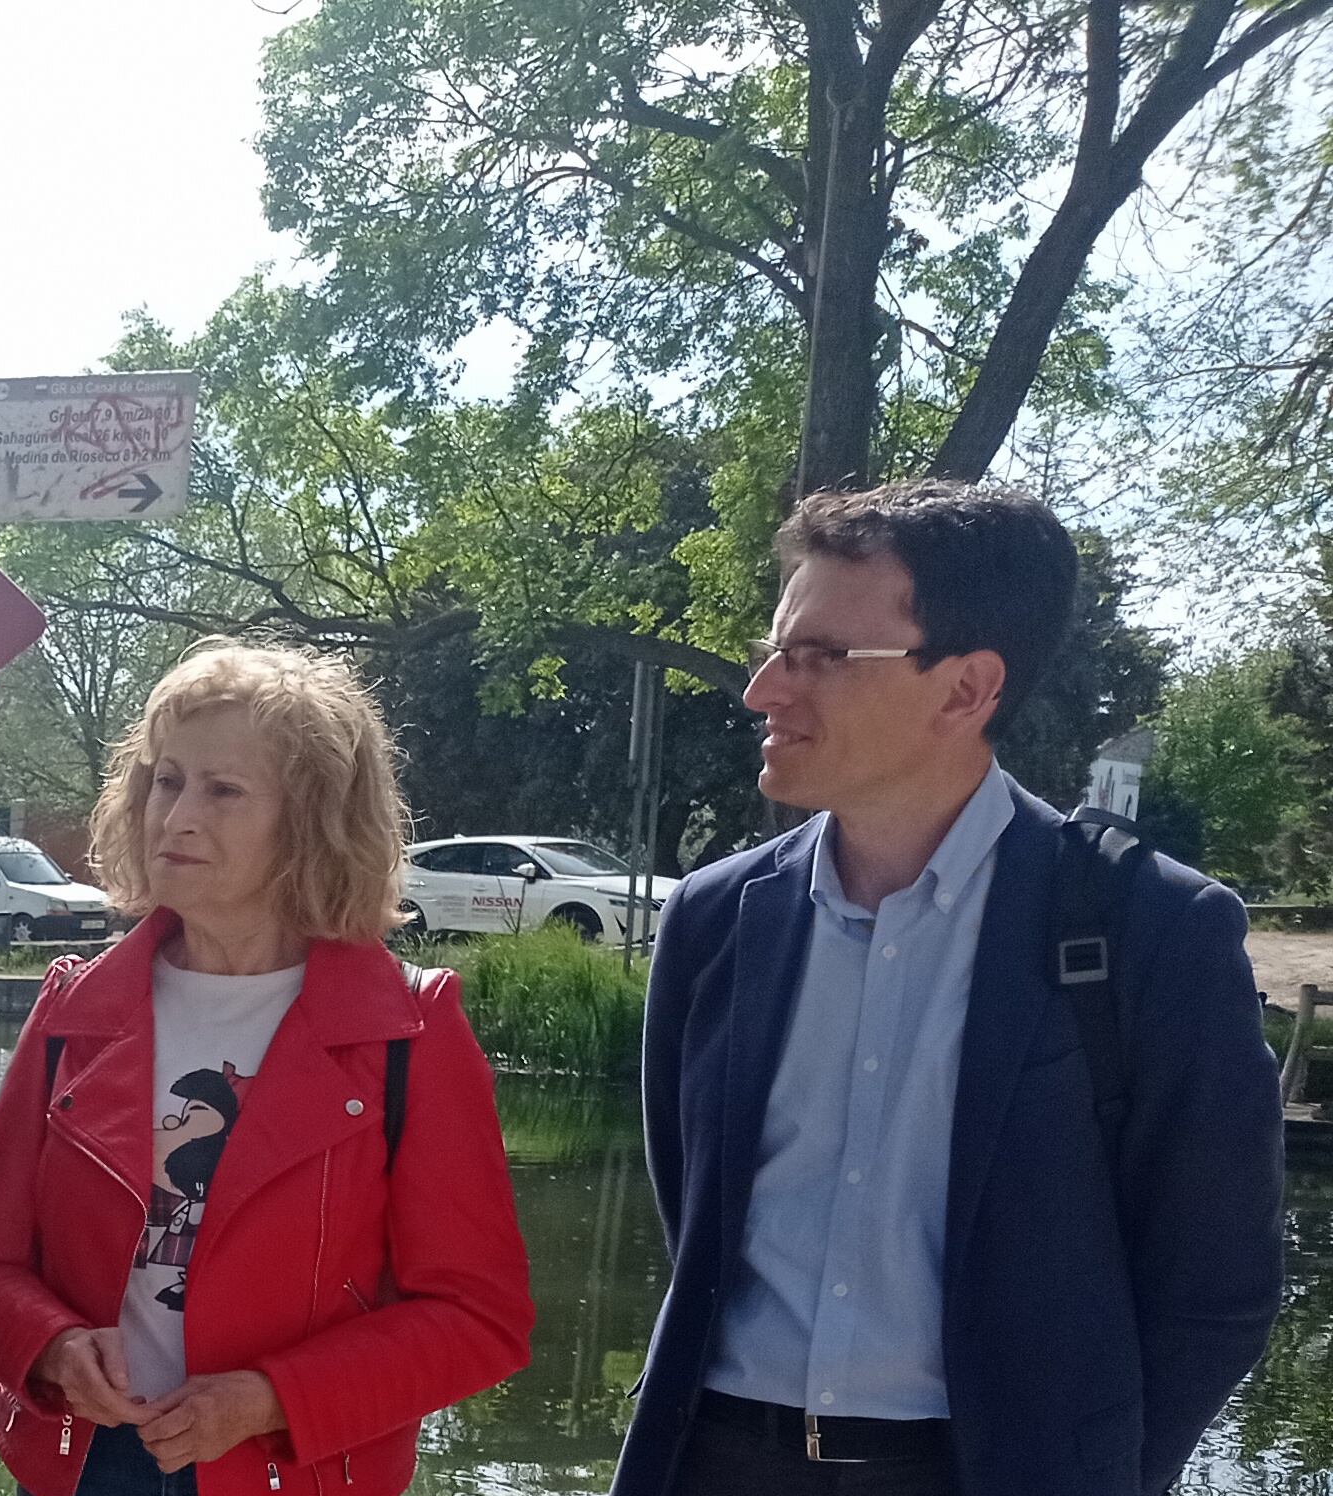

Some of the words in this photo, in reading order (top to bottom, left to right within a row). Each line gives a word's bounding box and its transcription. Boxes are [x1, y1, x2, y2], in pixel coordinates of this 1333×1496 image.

[5, 450, 49, 464] Medina
[51, 449, 67, 463] de
[151, 449, 171, 461] km
[472, 896, 522, 907] NISSAN
